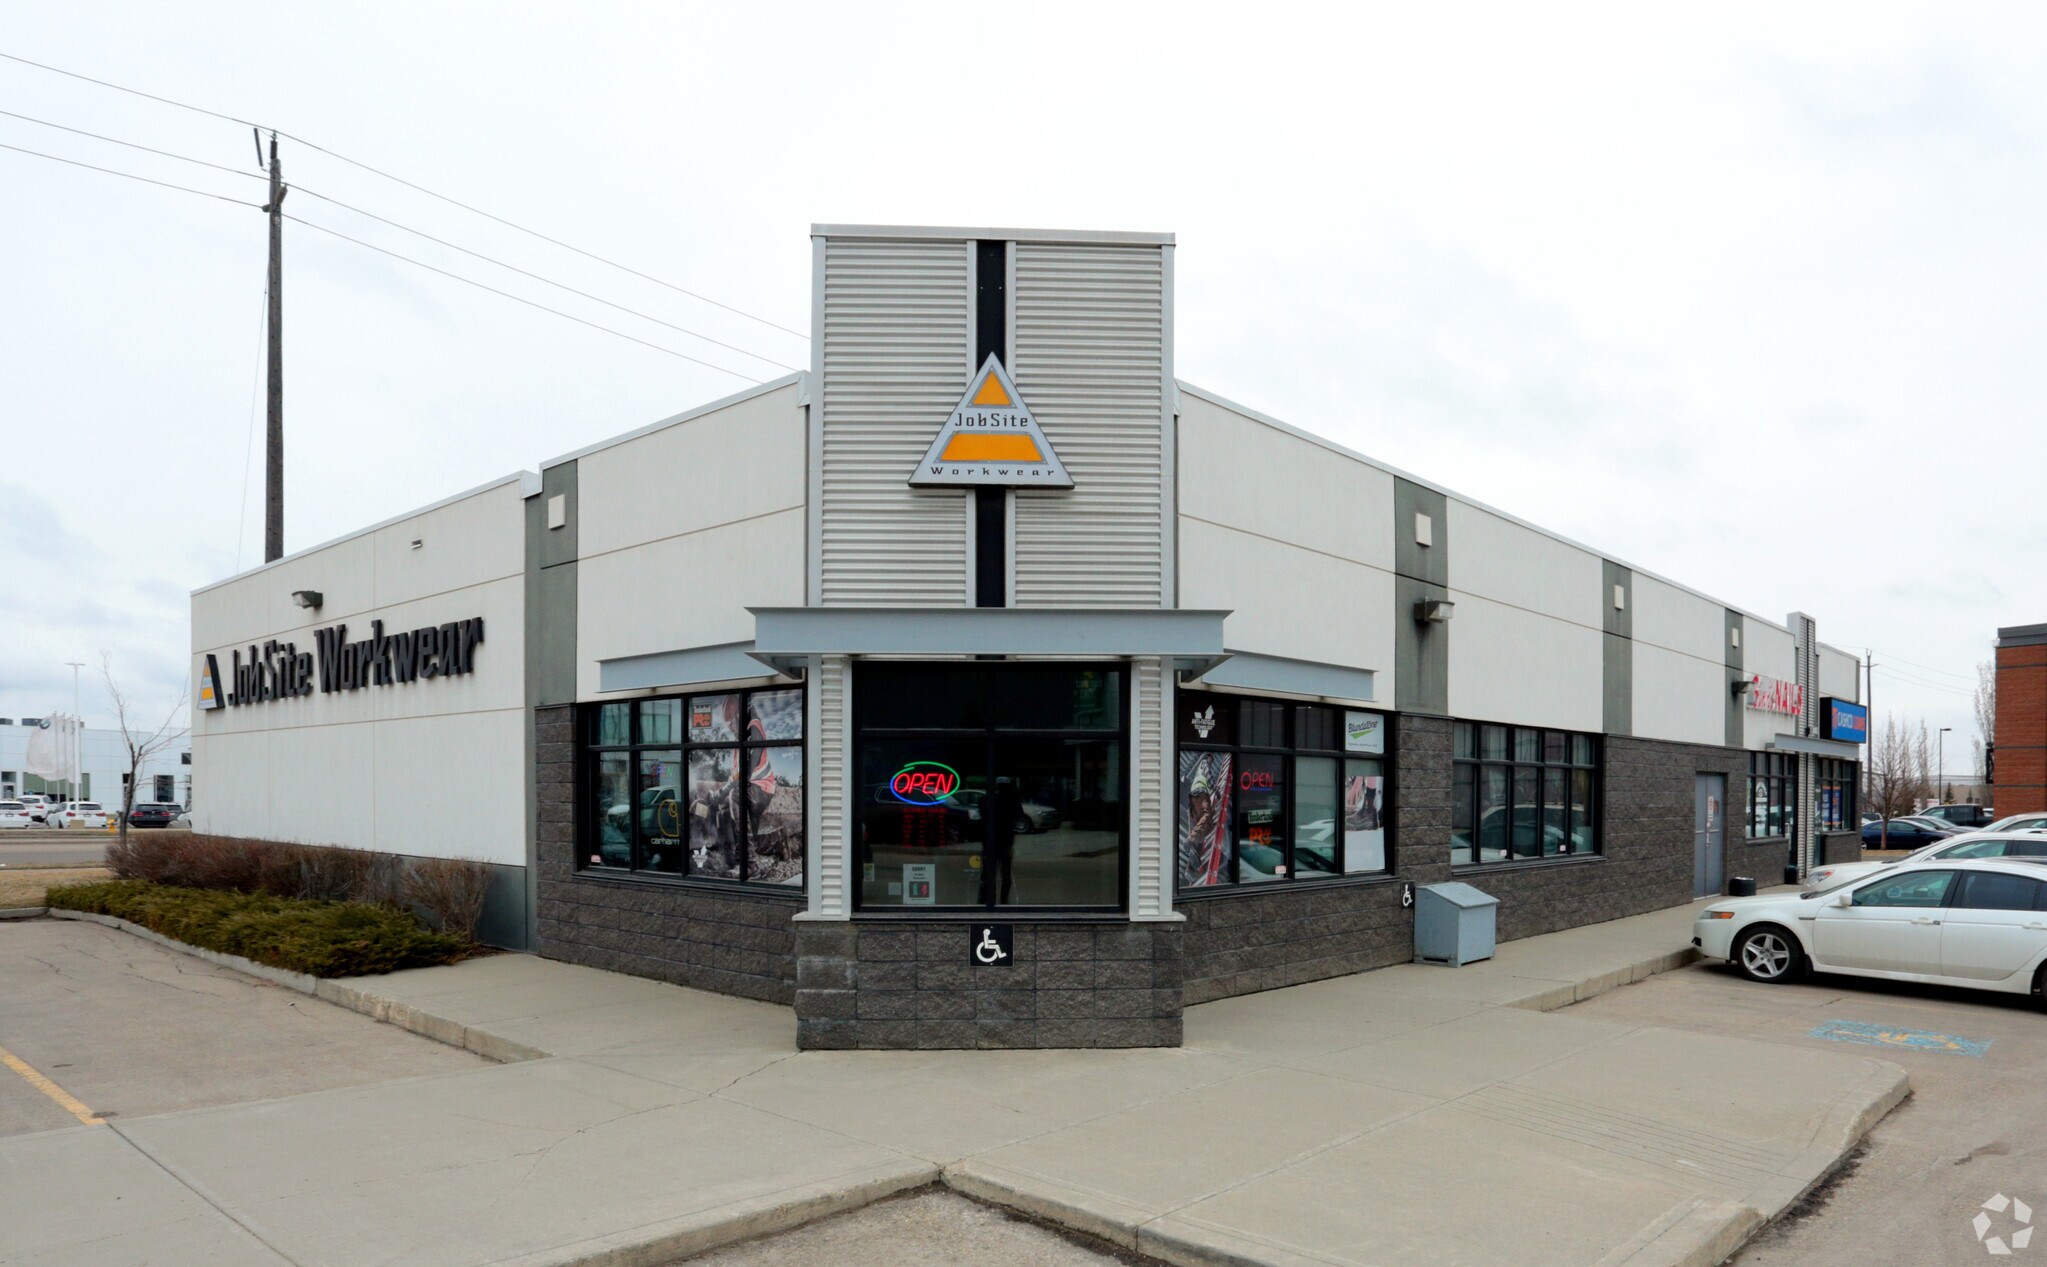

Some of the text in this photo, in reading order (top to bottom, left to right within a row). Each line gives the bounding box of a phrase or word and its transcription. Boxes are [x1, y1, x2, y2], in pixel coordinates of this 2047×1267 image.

[955, 413, 1028, 427] JobSite
[930, 467, 1054, 476] Workwear
[227, 616, 484, 706] JobSite Workwear
[1775, 679, 1803, 716] NAILS
[893, 773, 953, 794] OPEN
[1240, 771, 1275, 790] OPEN
[651, 837, 680, 845] carhartt
